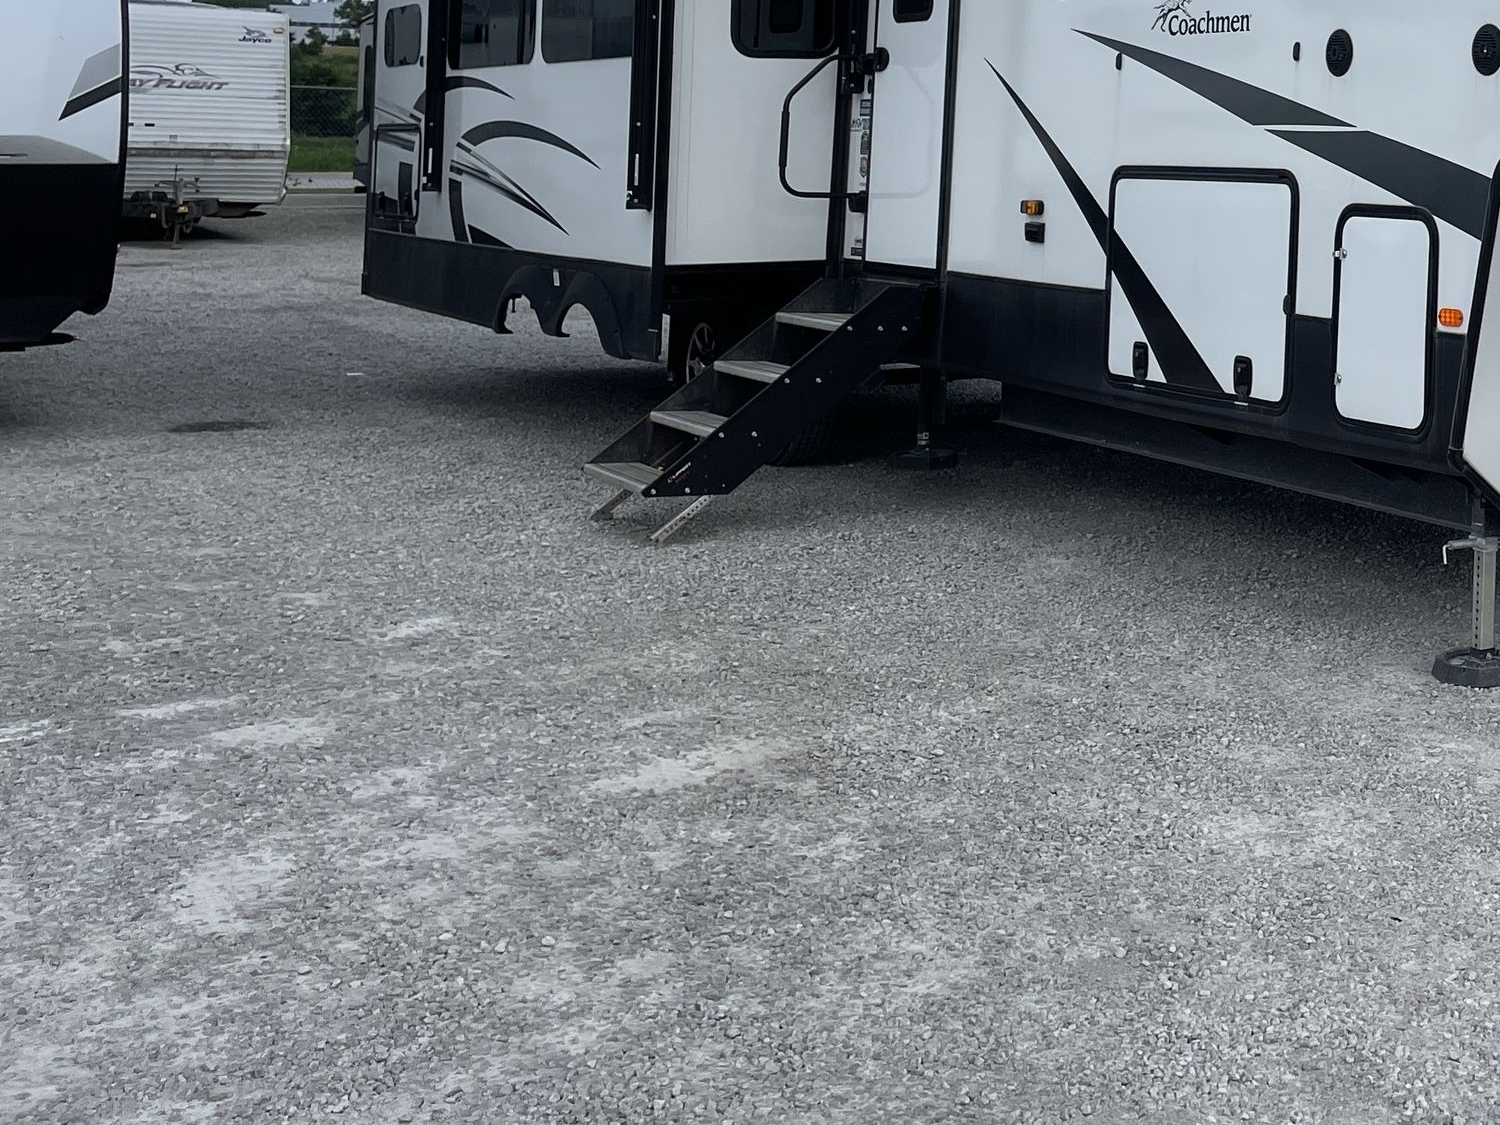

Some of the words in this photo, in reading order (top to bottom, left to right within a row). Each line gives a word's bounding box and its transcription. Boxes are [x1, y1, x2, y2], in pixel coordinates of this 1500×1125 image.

[1168, 10, 1251, 36] Coachmen
[238, 35, 272, 43] Jayco
[153, 78, 229, 90] FLIGHT
